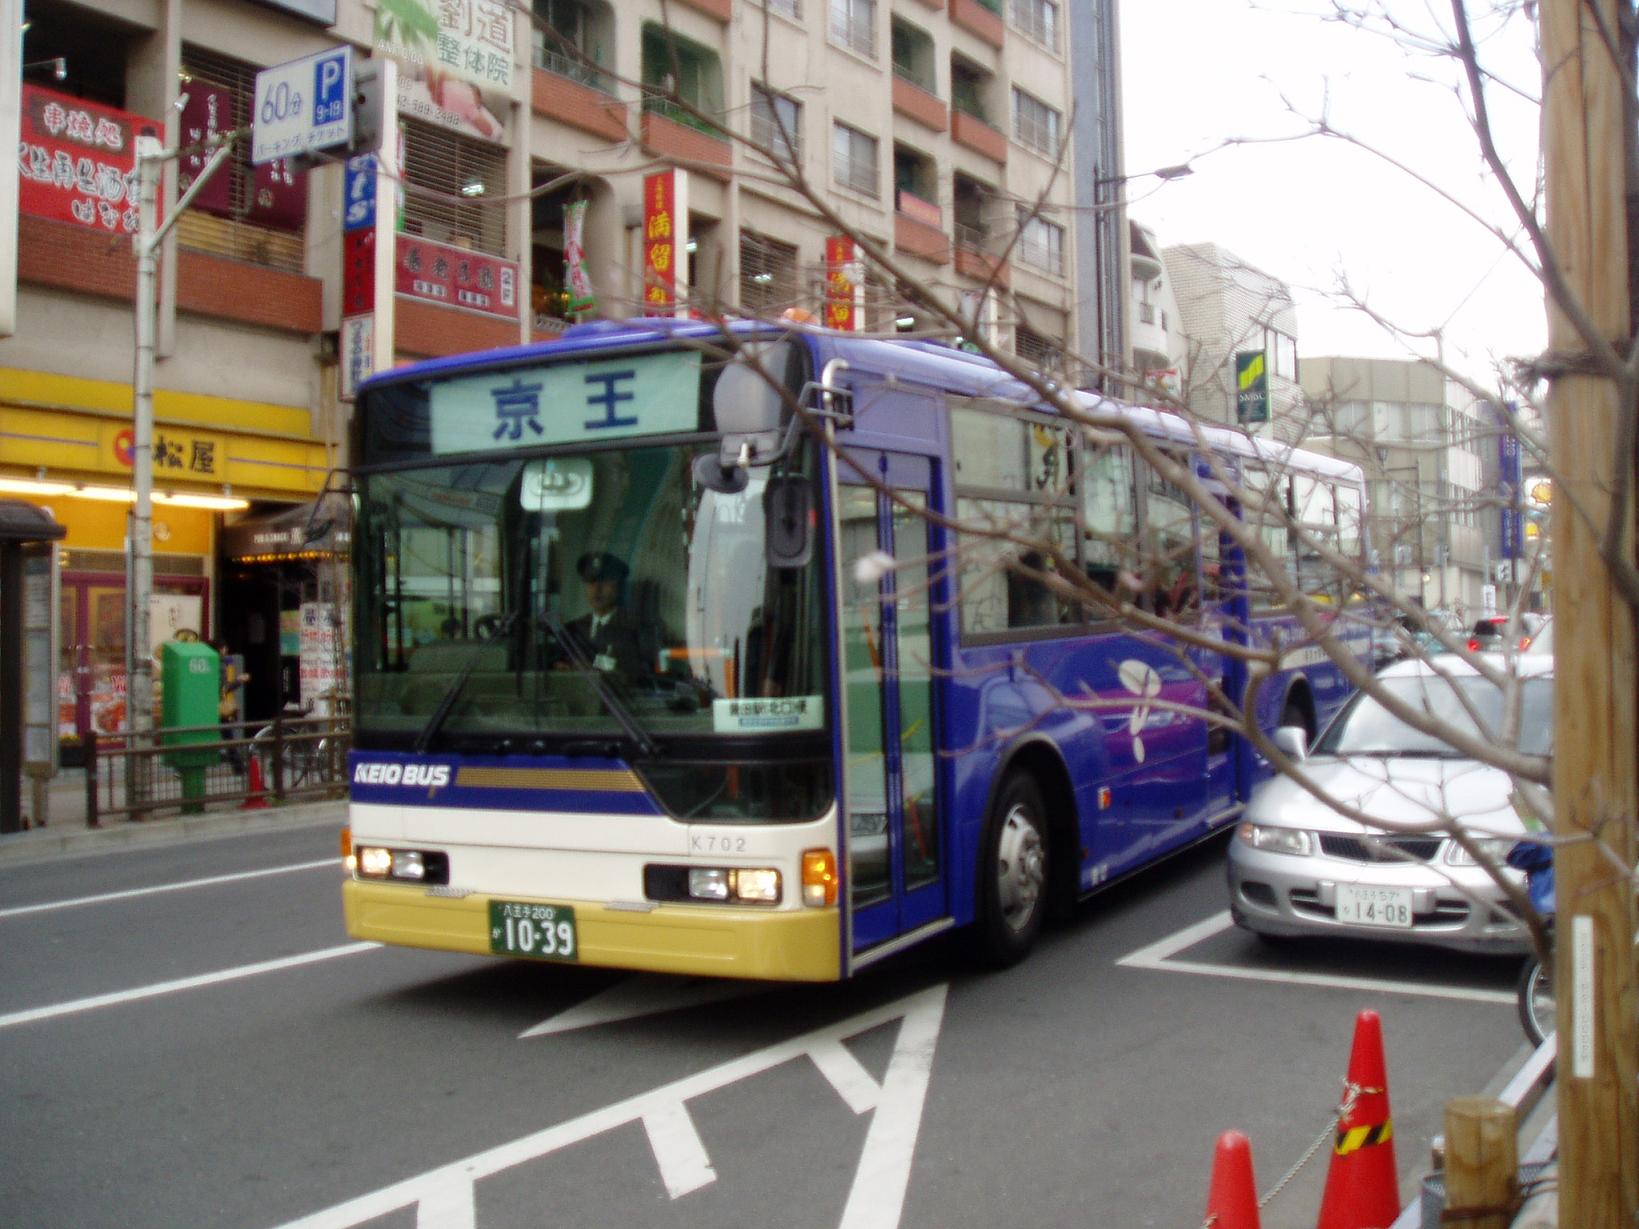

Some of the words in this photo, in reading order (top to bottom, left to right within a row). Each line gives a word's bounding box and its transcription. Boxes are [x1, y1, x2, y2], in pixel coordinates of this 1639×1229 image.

[437, 32, 508, 86] 整体院
[321, 60, 339, 103] P
[490, 369, 639, 441] 京王
[152, 434, 215, 474] 松屋
[354, 763, 403, 785] KEIO
[402, 764, 450, 787] BUS
[691, 836, 746, 852] K702
[1357, 902, 1408, 923] 14-08
[505, 918, 574, 956] 10-39
